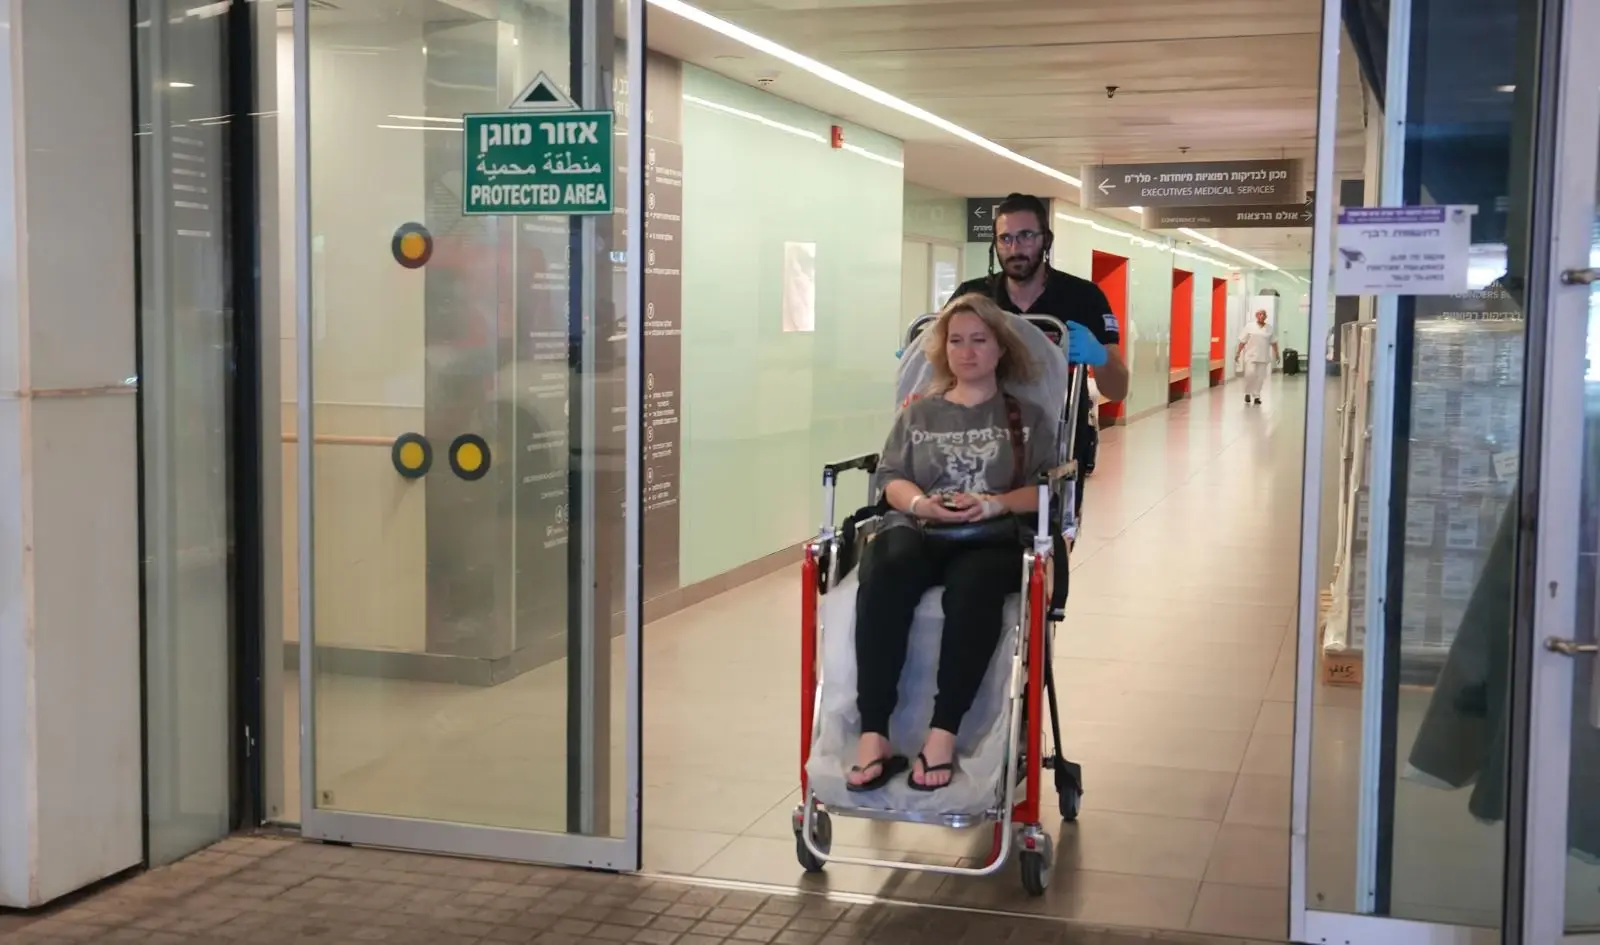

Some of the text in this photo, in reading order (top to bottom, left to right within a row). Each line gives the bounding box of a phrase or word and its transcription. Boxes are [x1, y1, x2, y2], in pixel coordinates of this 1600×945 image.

[480, 121, 598, 153] אזור מוגן
[476, 151, 601, 181] منطقة محمية
[1159, 173, 1193, 182] מיוחדות
[1195, 172, 1229, 181] רפואיות
[1231, 169, 1266, 182] לבדיקות
[1268, 170, 1287, 181] מכון
[471, 183, 607, 205] PROTECTED AREA
[1141, 185, 1275, 197] EXECUTIVES MEDICAL SERVICES
[1236, 211, 1299, 221] אולם הרצאות
